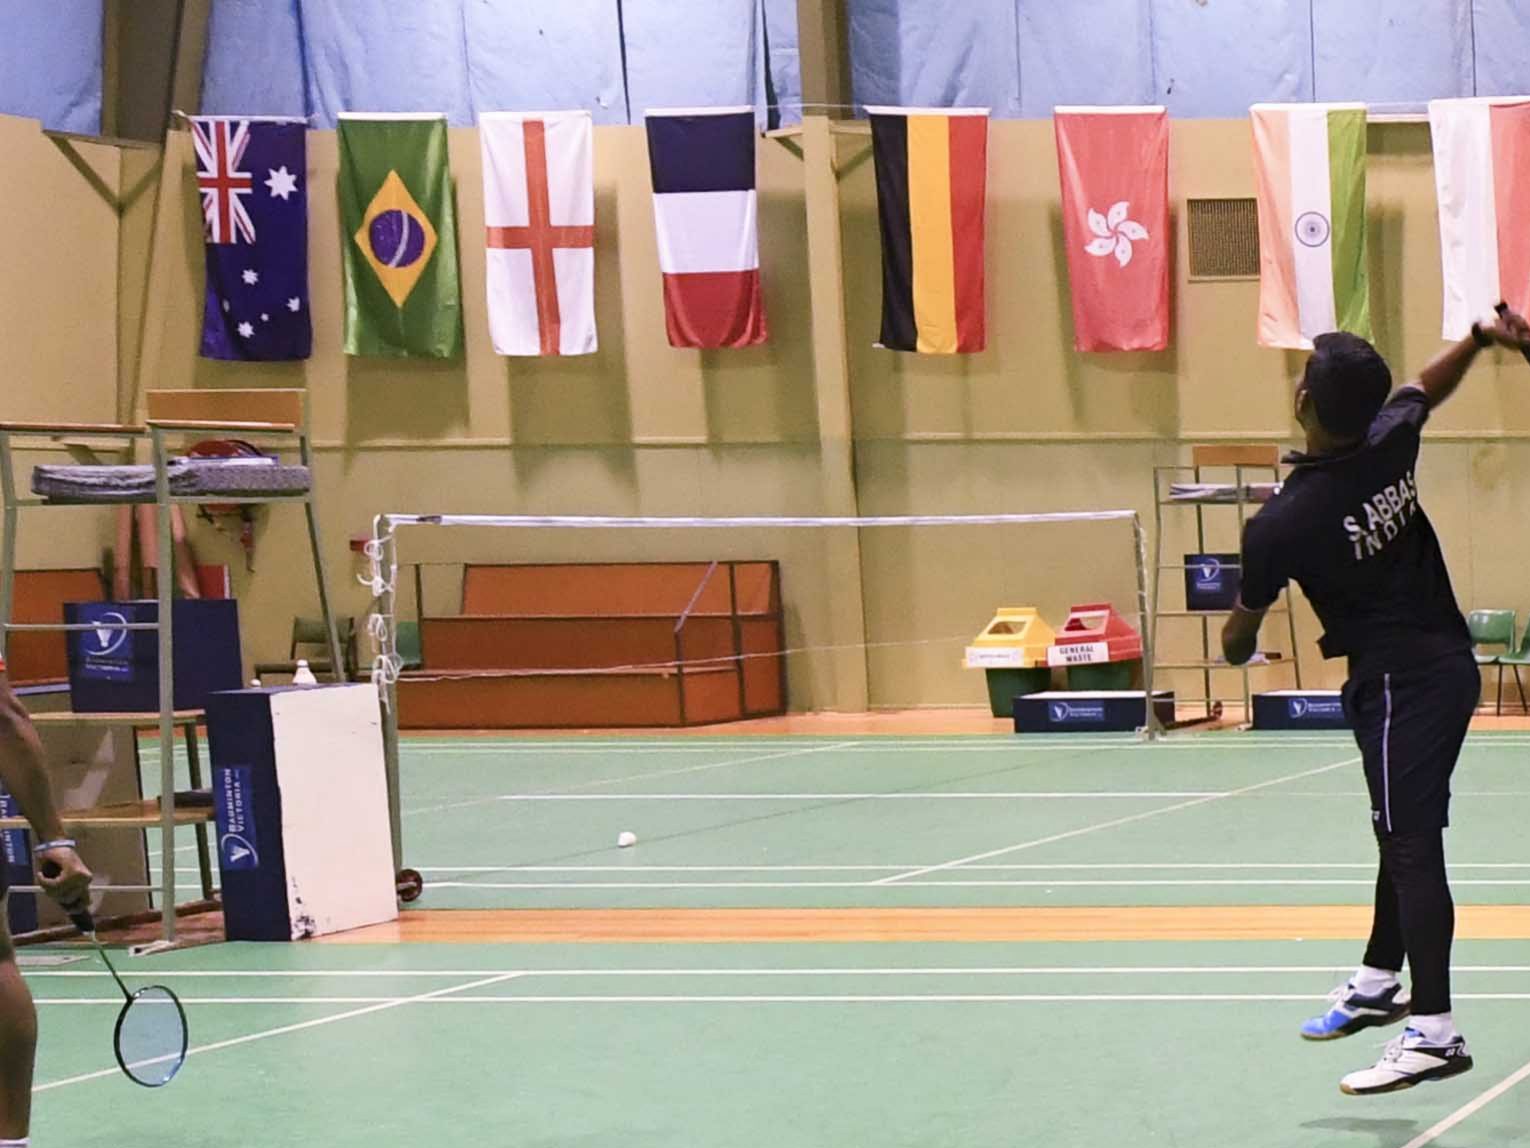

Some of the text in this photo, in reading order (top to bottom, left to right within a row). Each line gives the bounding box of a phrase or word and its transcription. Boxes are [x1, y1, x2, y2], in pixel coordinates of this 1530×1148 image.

[1362, 470, 1416, 531] ABBAS
[1353, 501, 1416, 560] INDIA
[1066, 653, 1092, 662] WASTE
